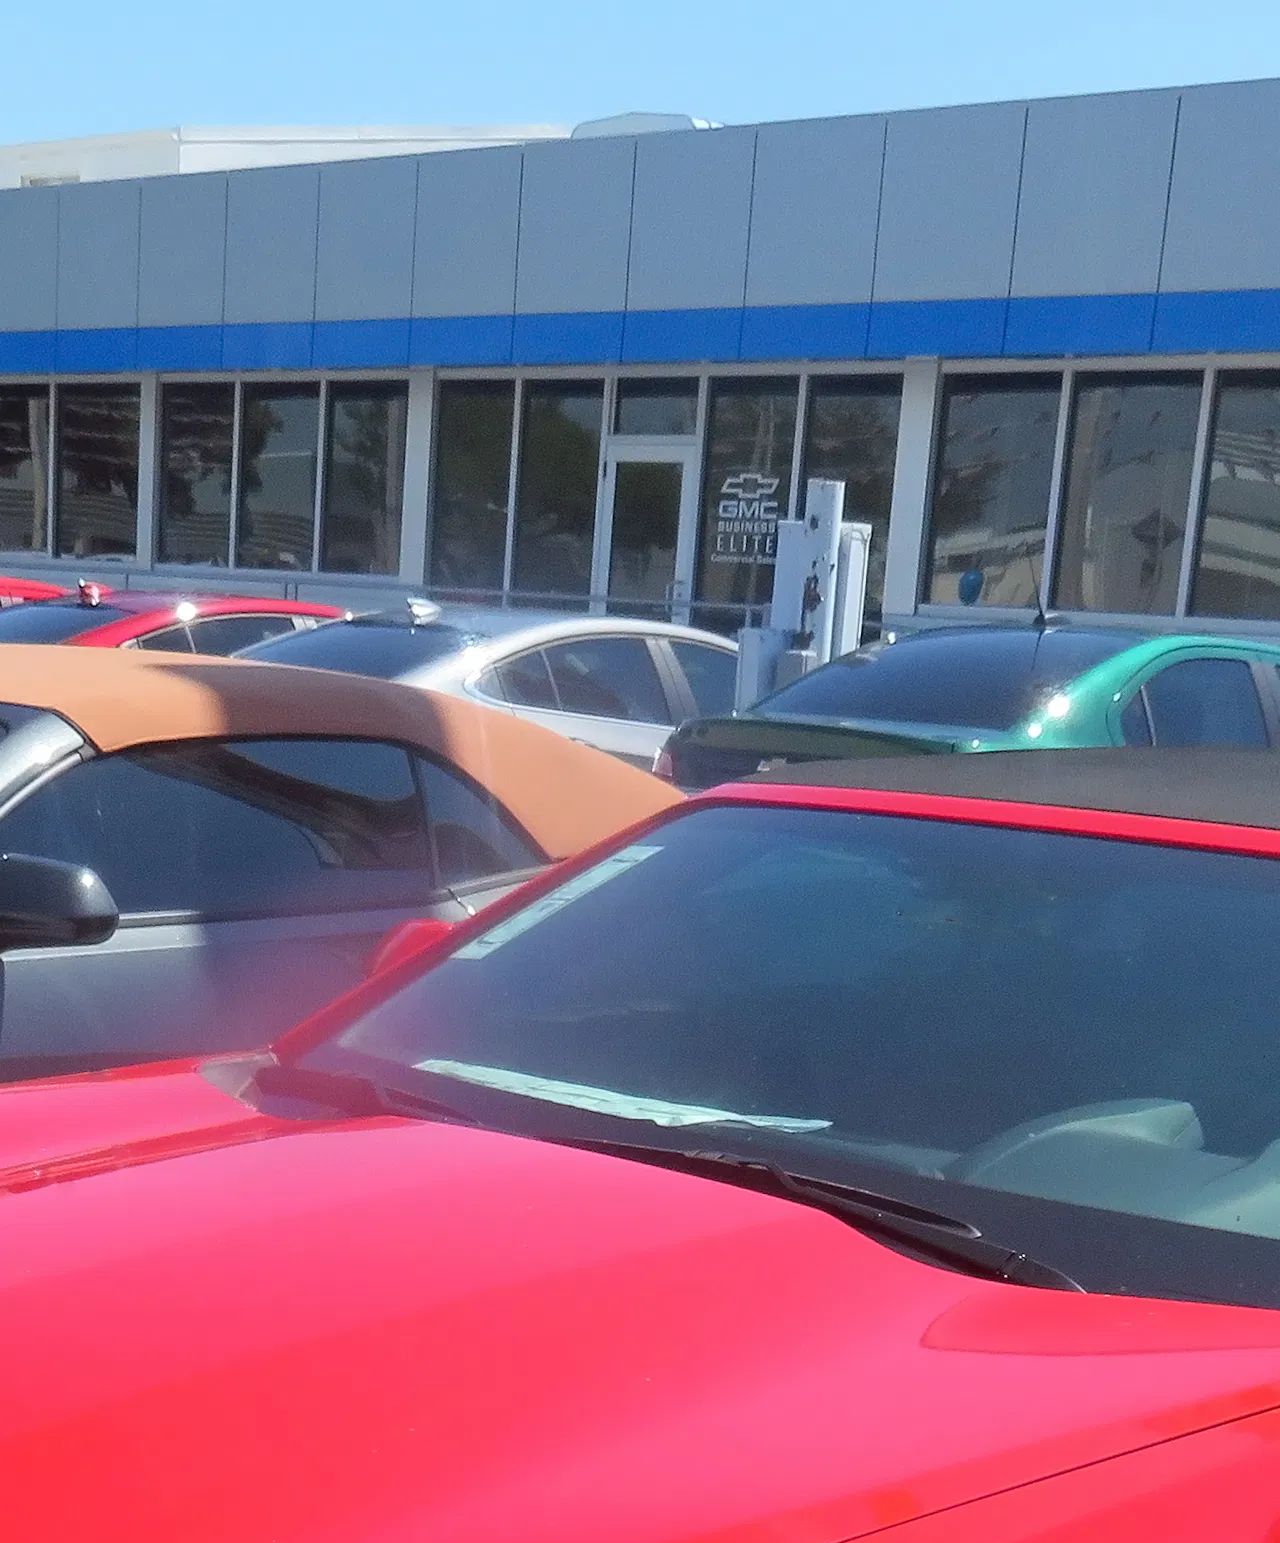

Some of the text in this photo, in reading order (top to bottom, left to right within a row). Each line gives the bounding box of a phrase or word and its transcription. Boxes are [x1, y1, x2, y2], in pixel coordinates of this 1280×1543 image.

[719, 500, 778, 519] GMC
[718, 520, 776, 533] BUSINESS
[716, 534, 775, 554] ELITE
